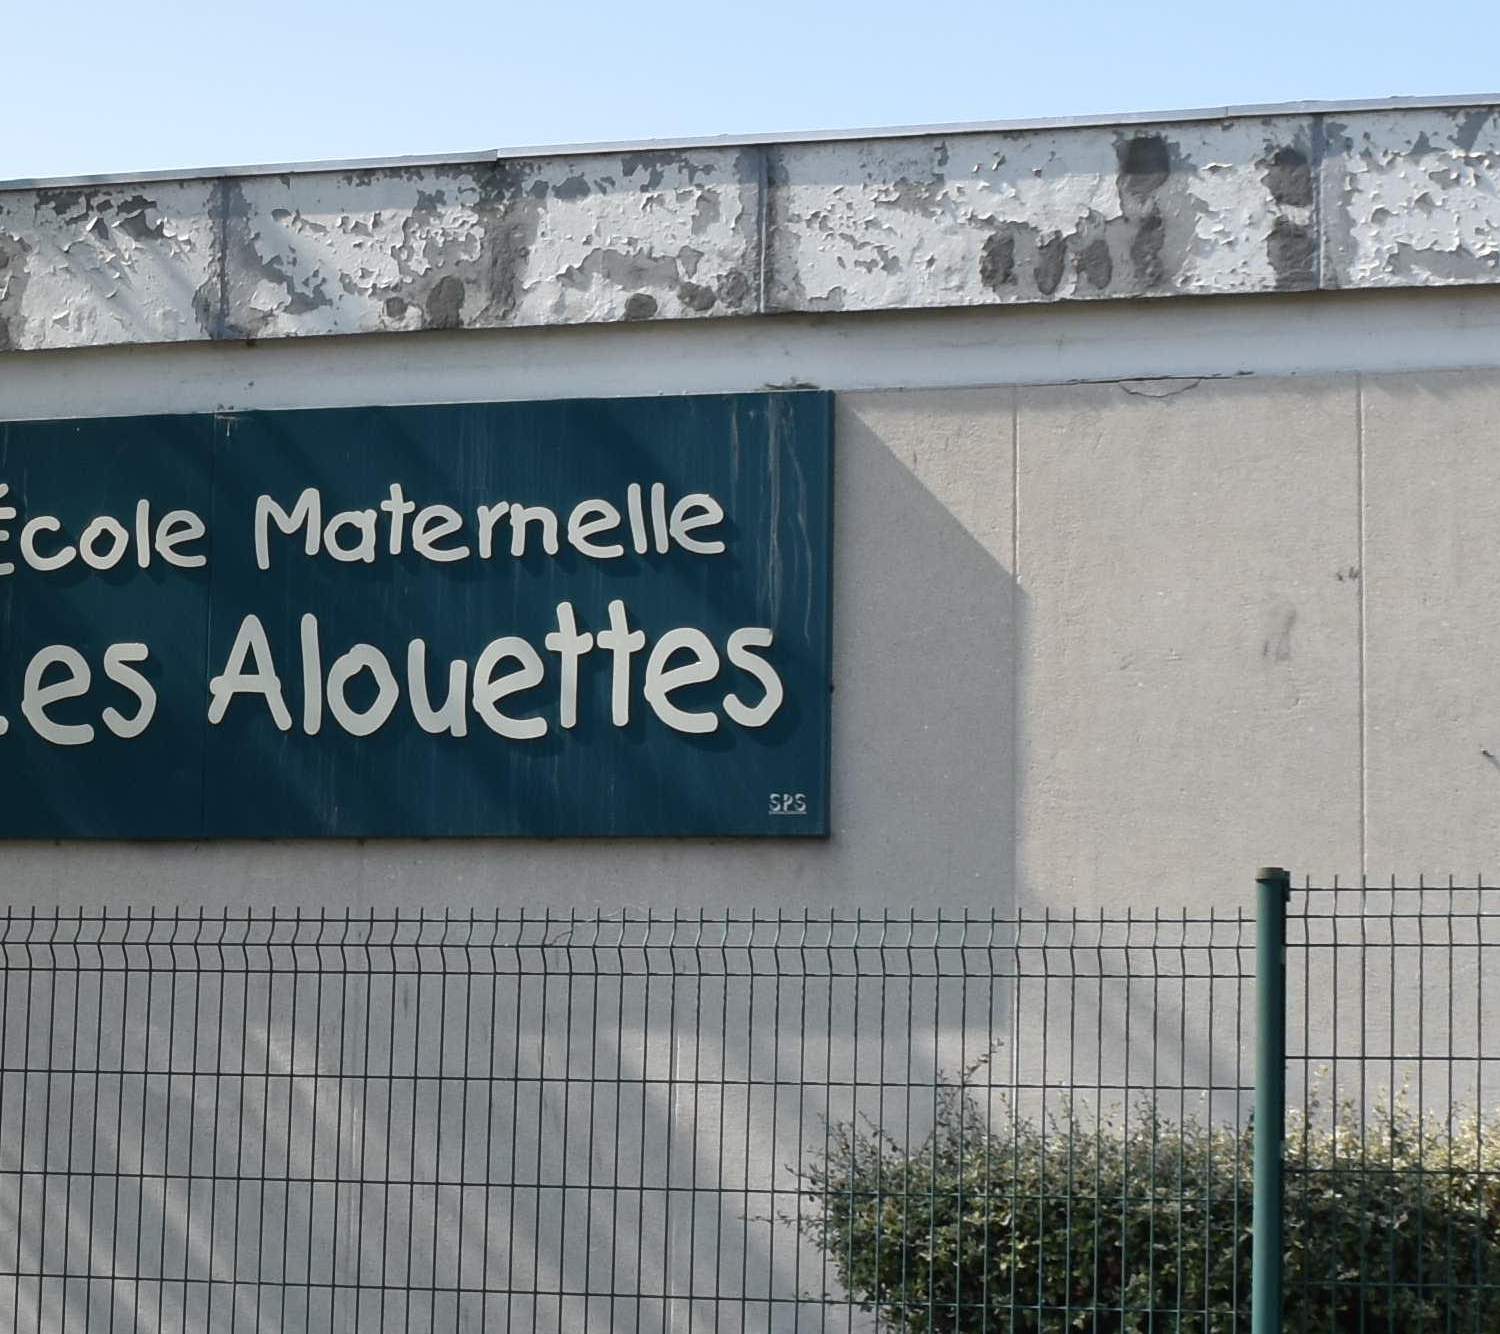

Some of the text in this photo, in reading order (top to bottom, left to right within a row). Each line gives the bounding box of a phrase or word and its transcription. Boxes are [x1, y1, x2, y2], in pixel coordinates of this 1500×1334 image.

[254, 481, 726, 570] Maternelle
[207, 598, 785, 740] Alouettes
[768, 793, 807, 812] SPS
